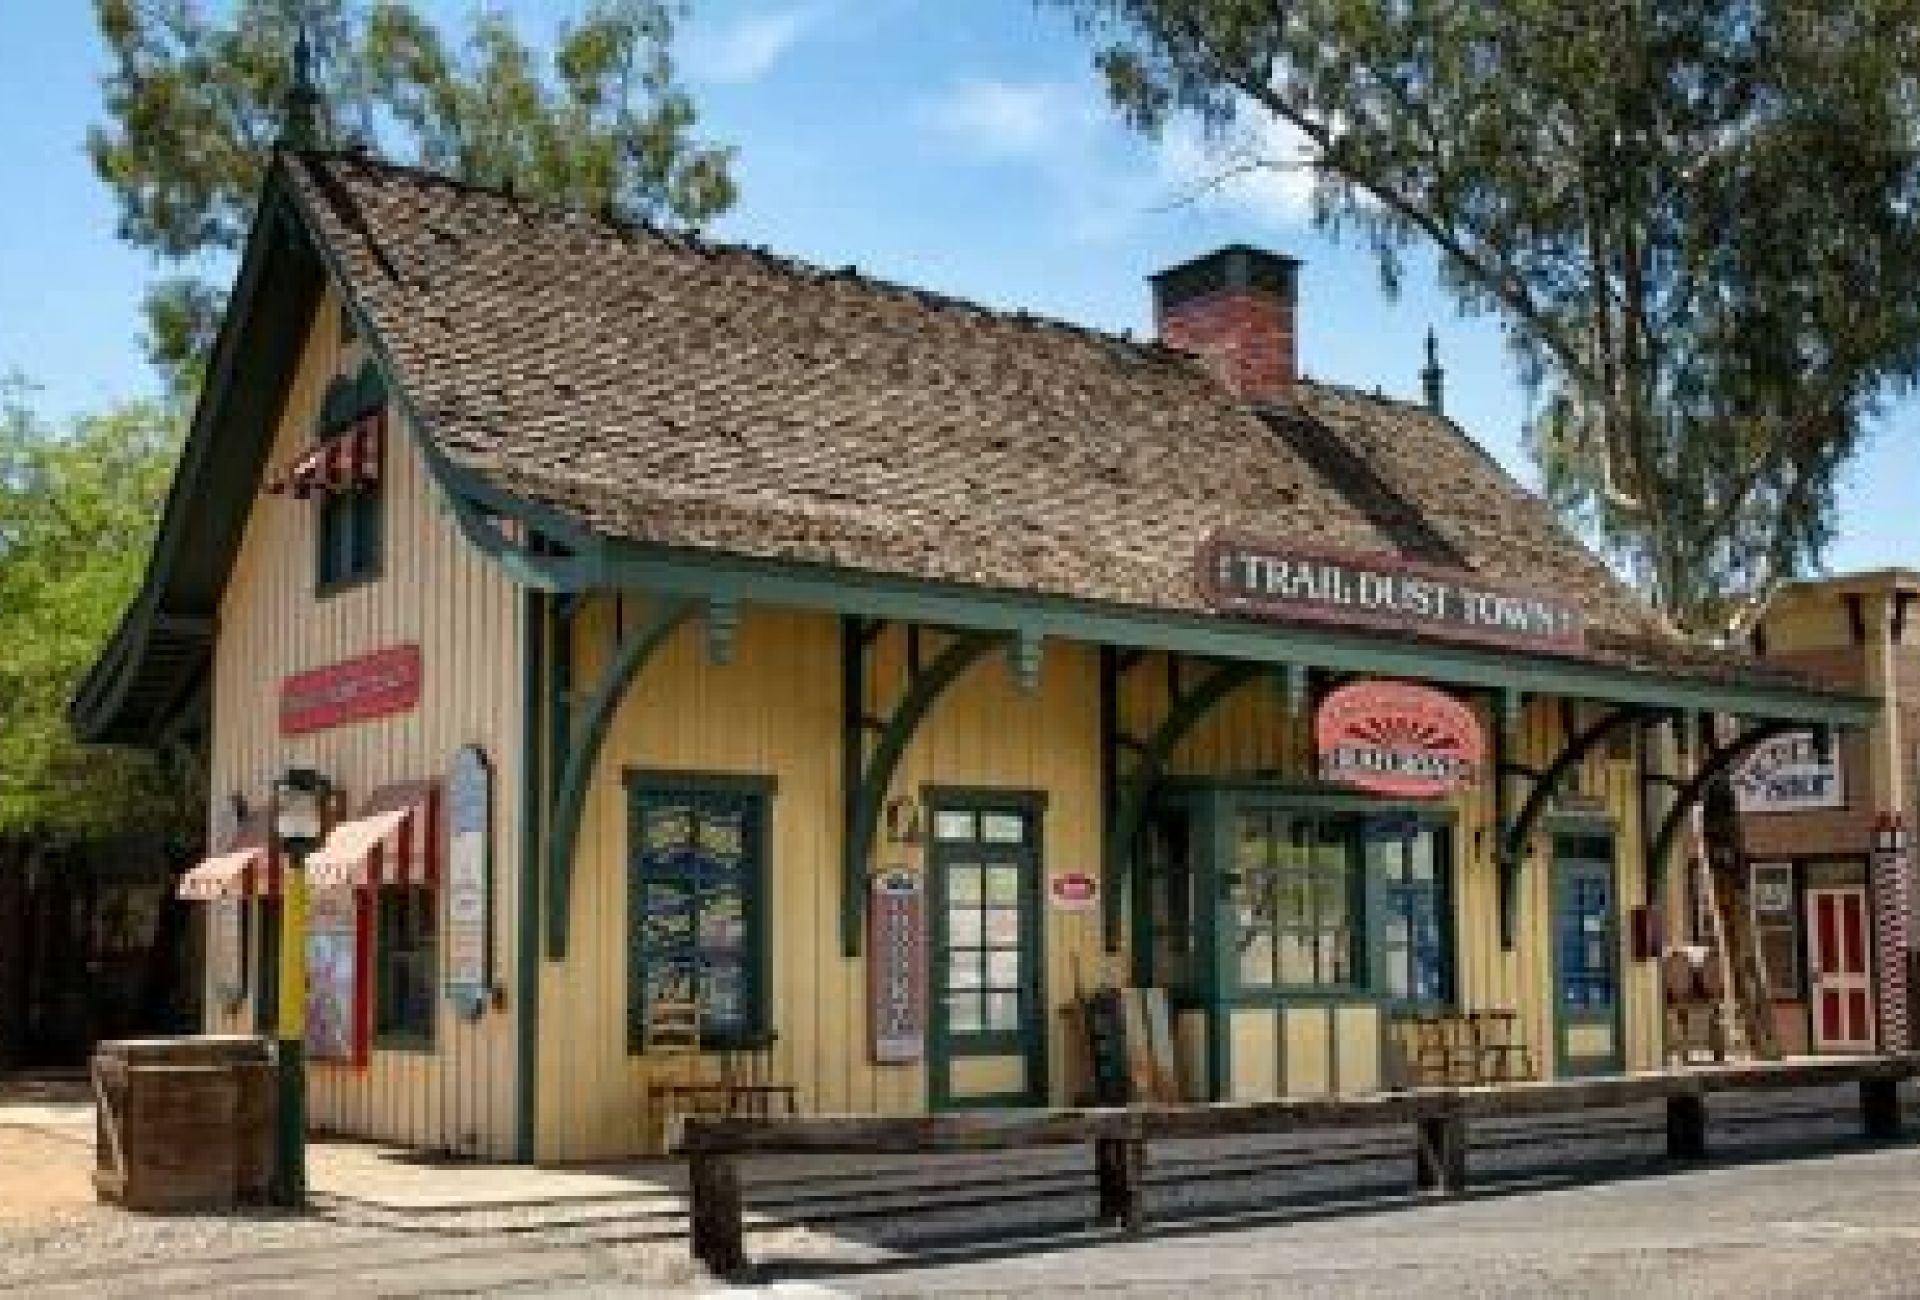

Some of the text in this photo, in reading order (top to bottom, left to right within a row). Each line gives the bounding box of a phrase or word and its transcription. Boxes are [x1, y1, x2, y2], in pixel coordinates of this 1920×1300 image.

[1244, 553, 1555, 637] TRAIL DUST TOWN
